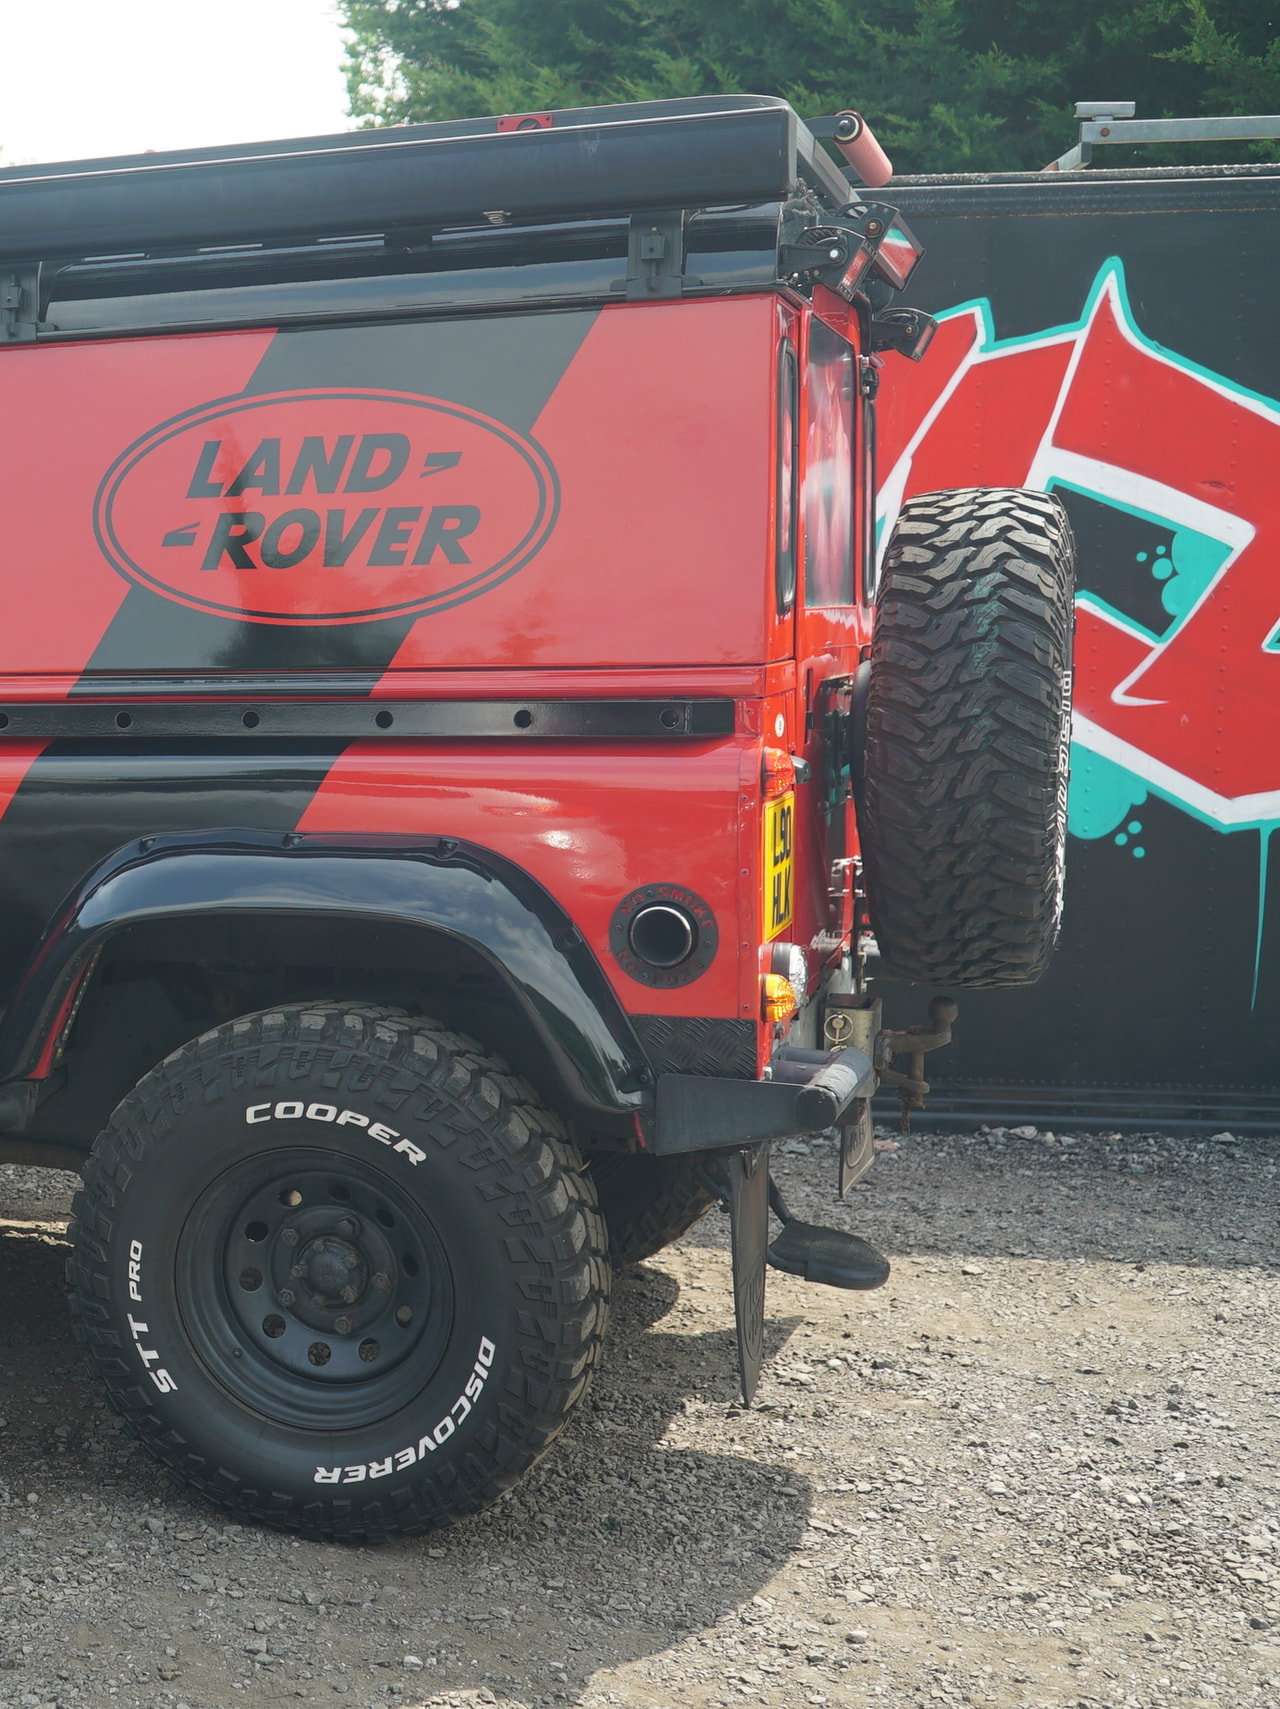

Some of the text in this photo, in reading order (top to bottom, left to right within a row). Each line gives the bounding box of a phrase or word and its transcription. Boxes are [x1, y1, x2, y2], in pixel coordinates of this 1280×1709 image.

[773, 805, 792, 866] L90
[772, 864, 791, 930] HLK
[245, 1101, 427, 1166] COOPER
[127, 1239, 178, 1393] STT PRO
[313, 1335, 496, 1484] DISCOVERER
